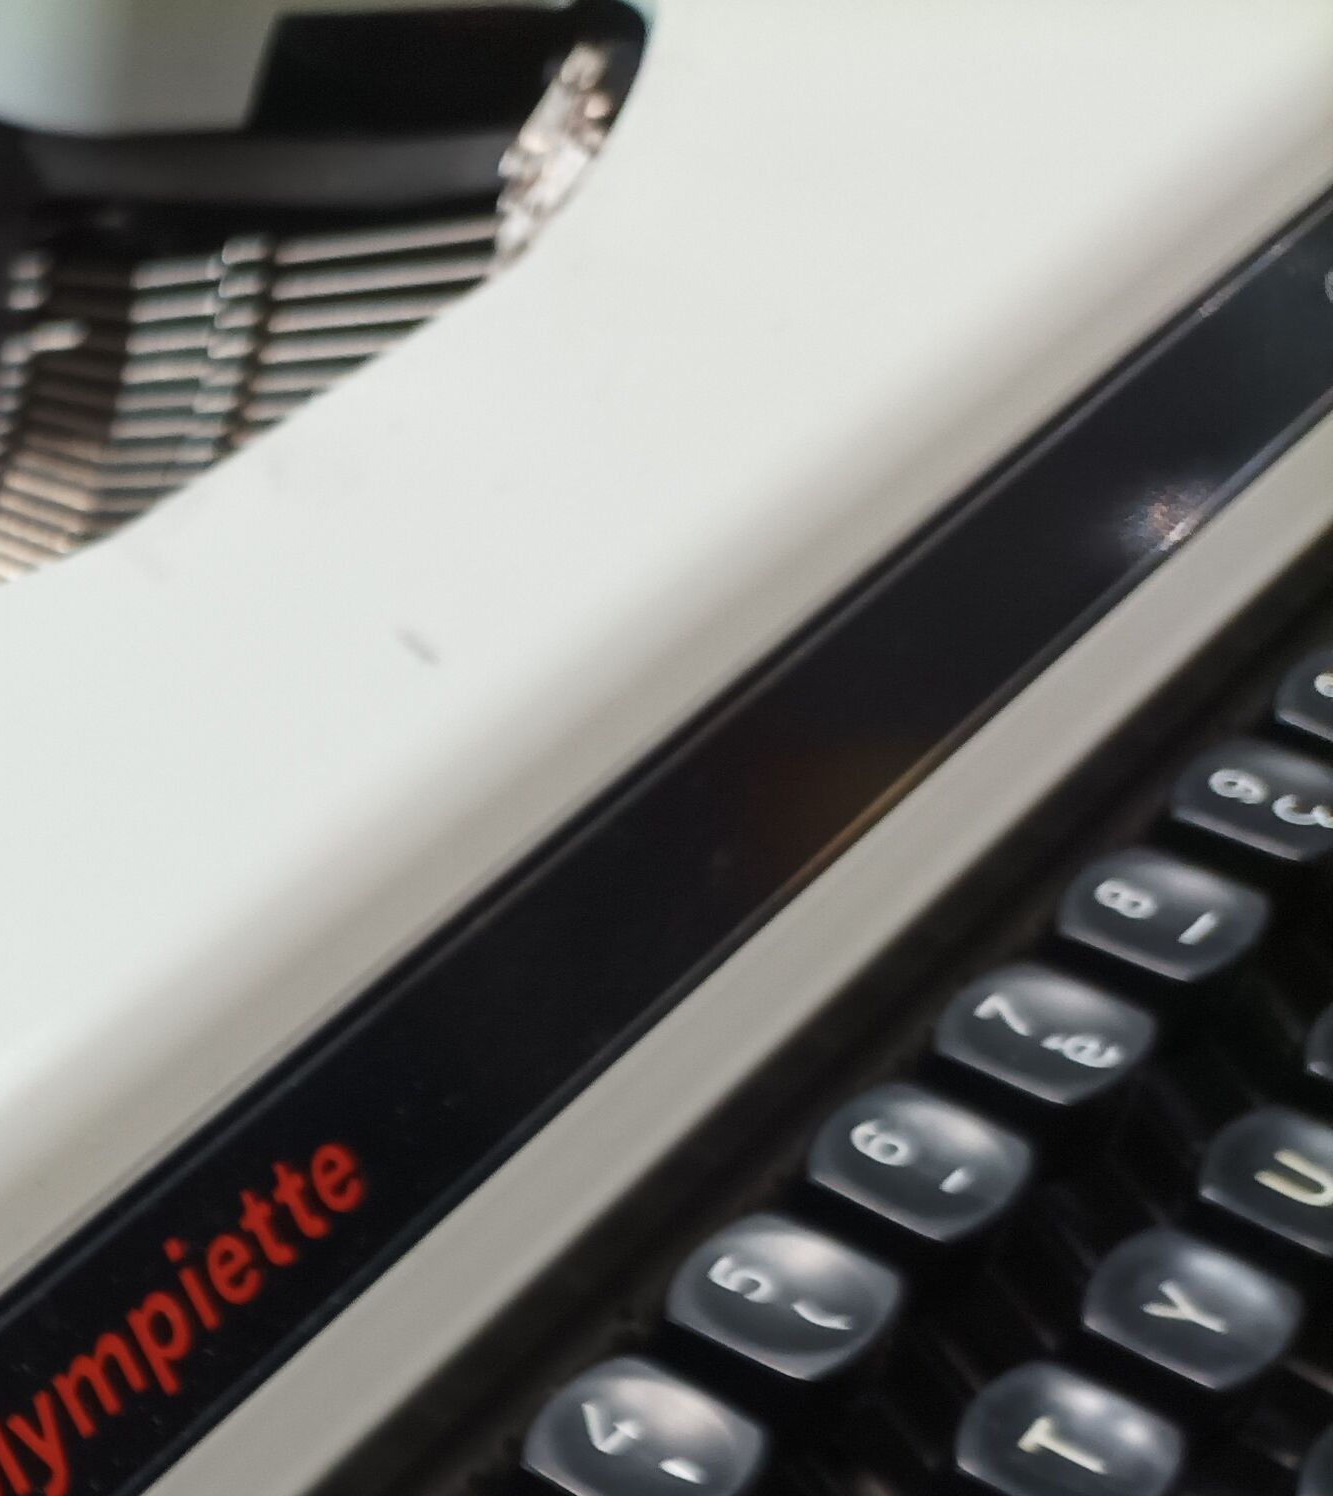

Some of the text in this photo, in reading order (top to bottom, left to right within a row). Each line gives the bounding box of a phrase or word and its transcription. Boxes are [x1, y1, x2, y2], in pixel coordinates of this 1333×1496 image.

[1094, 878, 1160, 920] 8
[974, 994, 1031, 1036] 7
[849, 1118, 913, 1167] 6
[1254, 1149, 1333, 1207] U
[707, 1255, 777, 1303] 5
[1141, 1279, 1230, 1335] Y
[581, 1402, 644, 1456] 4
[1017, 1414, 1108, 1475] T
